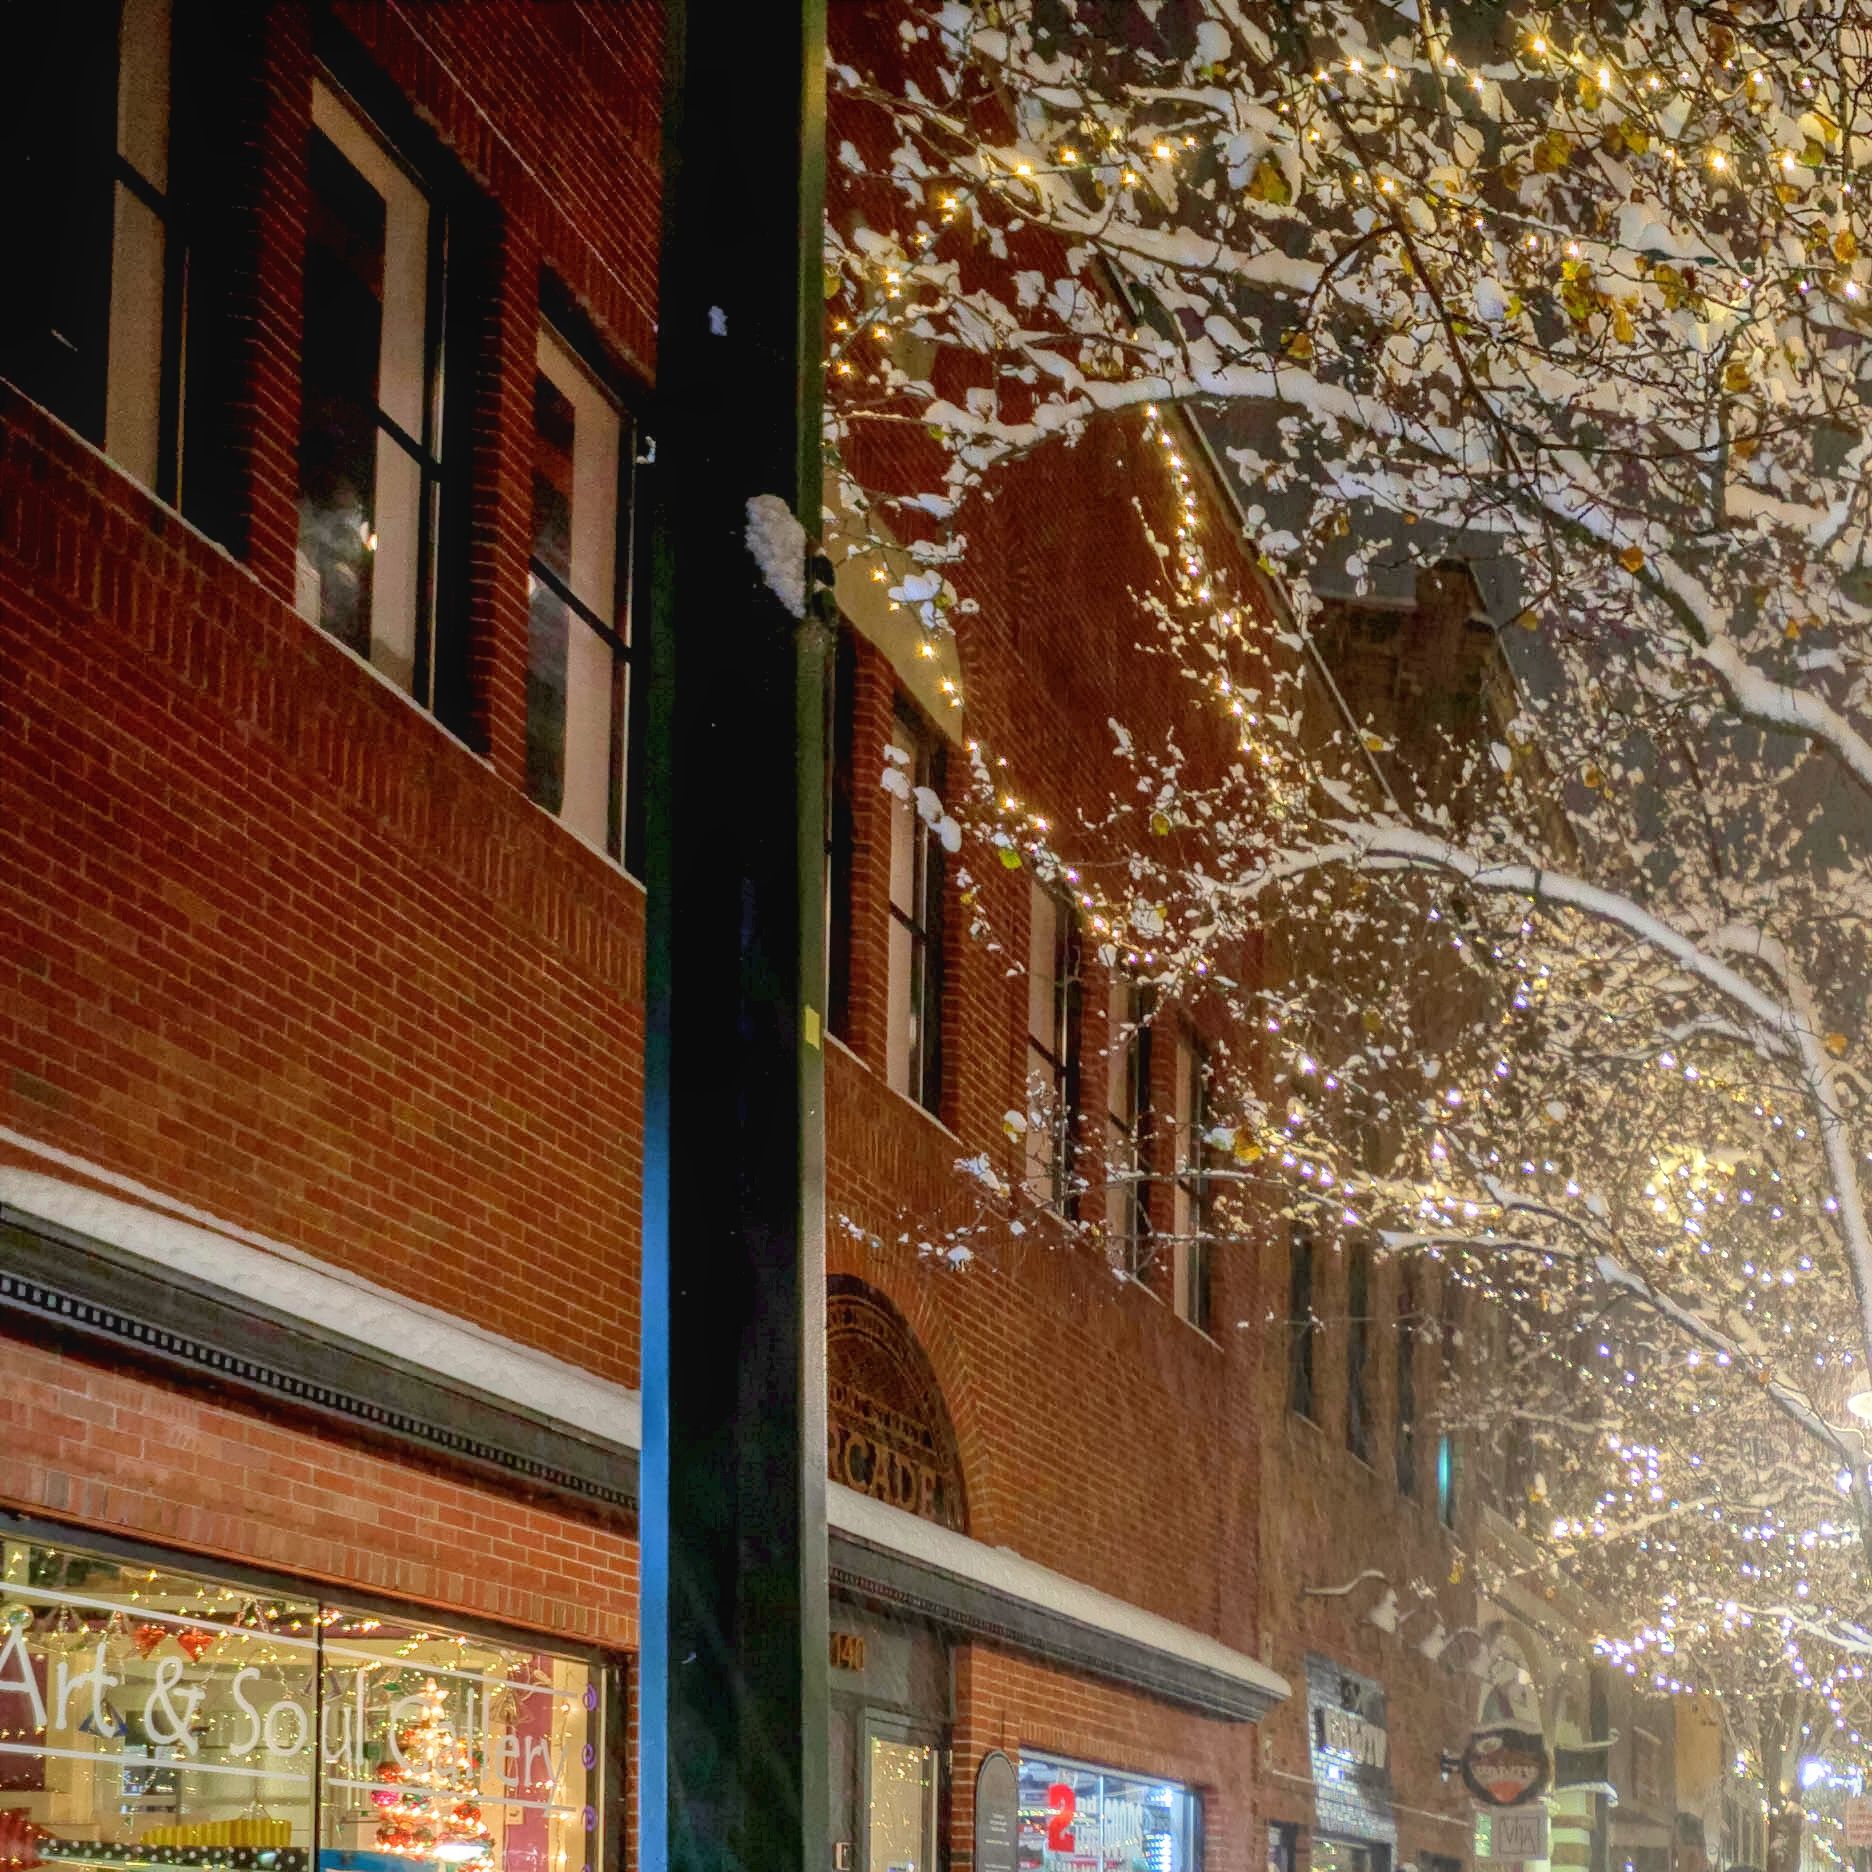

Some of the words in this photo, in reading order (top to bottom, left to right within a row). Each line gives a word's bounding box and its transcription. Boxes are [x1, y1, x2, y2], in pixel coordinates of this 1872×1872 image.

[0, 1626, 119, 1738] Art
[144, 1655, 207, 1756] &
[229, 1666, 367, 1768] Soul
[389, 1686, 569, 1818] Gallery
